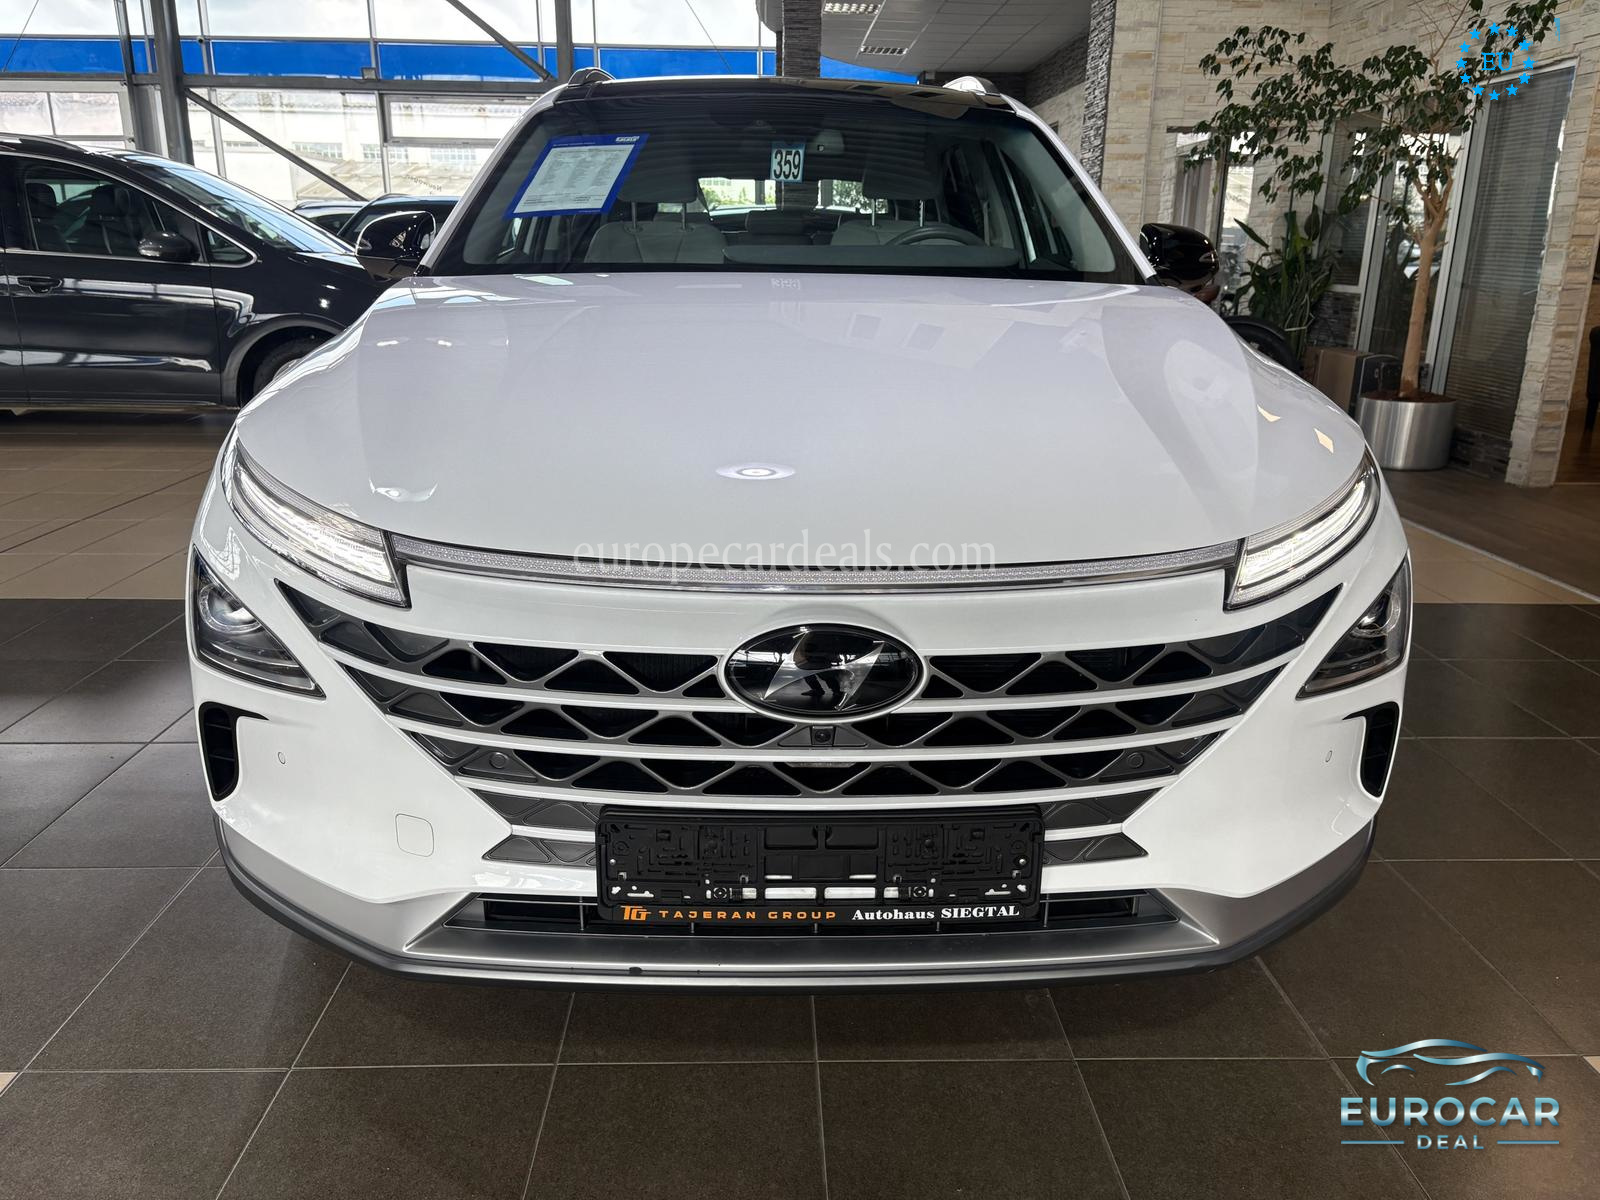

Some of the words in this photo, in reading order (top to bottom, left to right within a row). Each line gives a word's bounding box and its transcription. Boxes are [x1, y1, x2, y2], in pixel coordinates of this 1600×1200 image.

[773, 149, 801, 179] 359
[658, 910, 757, 920] TAJERAN
[768, 911, 836, 920] GROUP
[852, 909, 935, 920] Autohaus
[940, 905, 1020, 919] SIEGTAL
